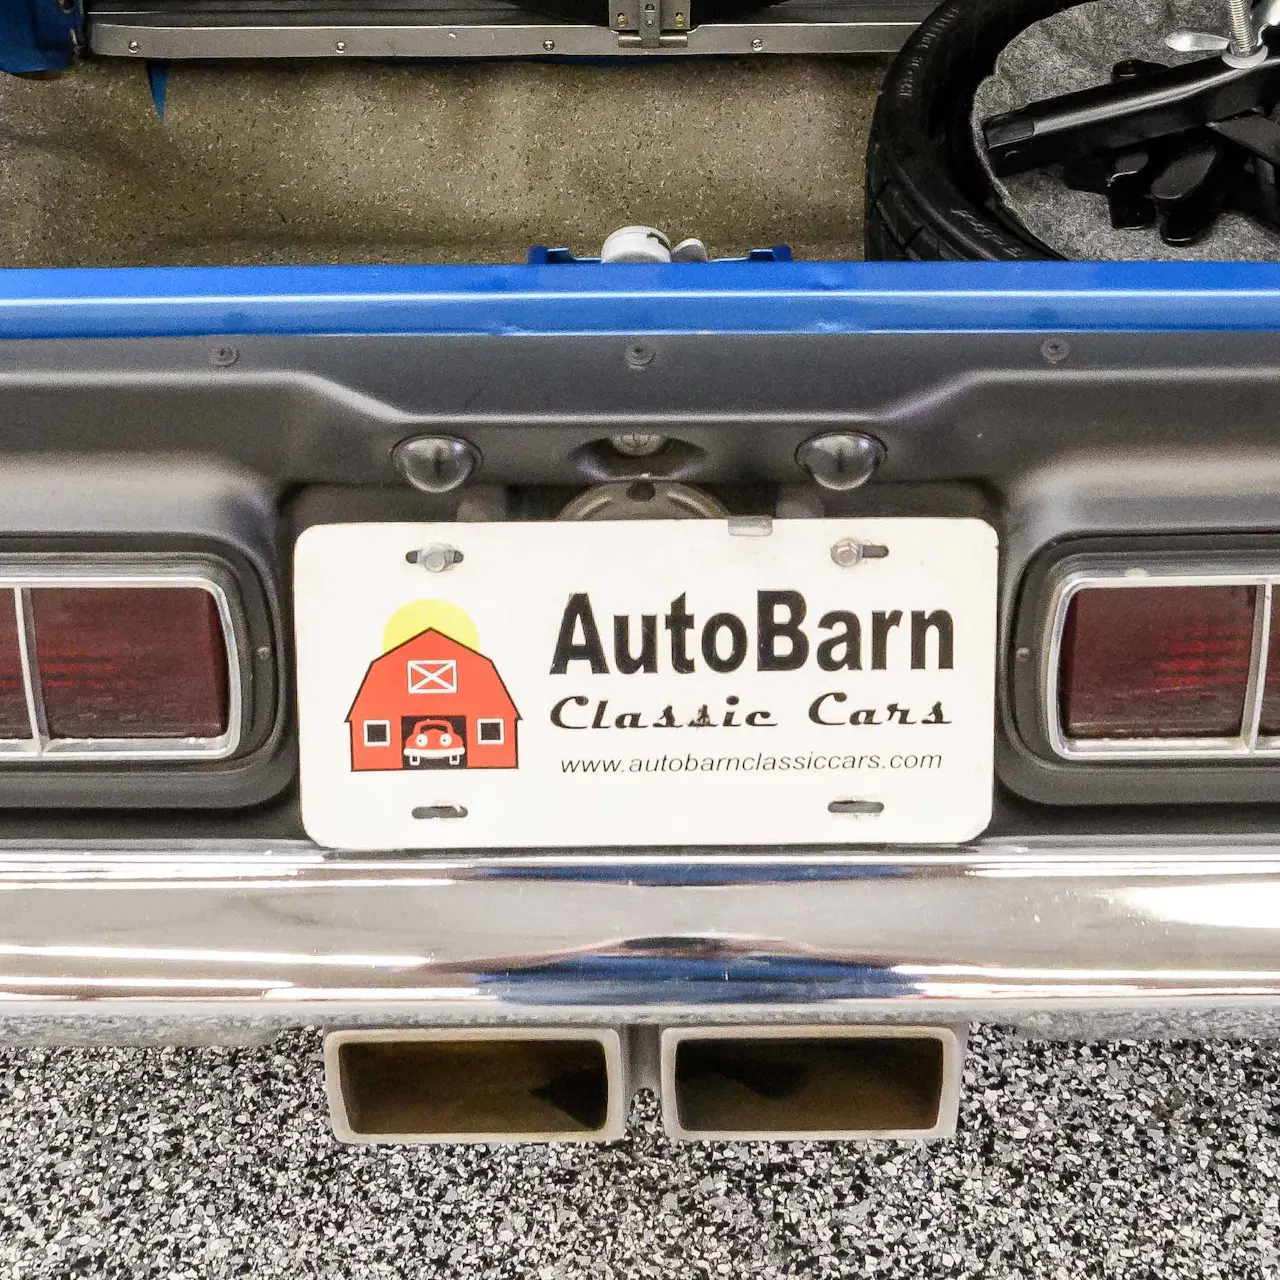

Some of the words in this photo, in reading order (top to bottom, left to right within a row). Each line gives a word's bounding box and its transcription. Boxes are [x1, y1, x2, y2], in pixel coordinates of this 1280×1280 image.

[549, 588, 954, 675] AutoBarn
[549, 694, 778, 730] Classic
[807, 691, 953, 727] Cars
[560, 750, 943, 774] www.autobarnclassiccars.com
